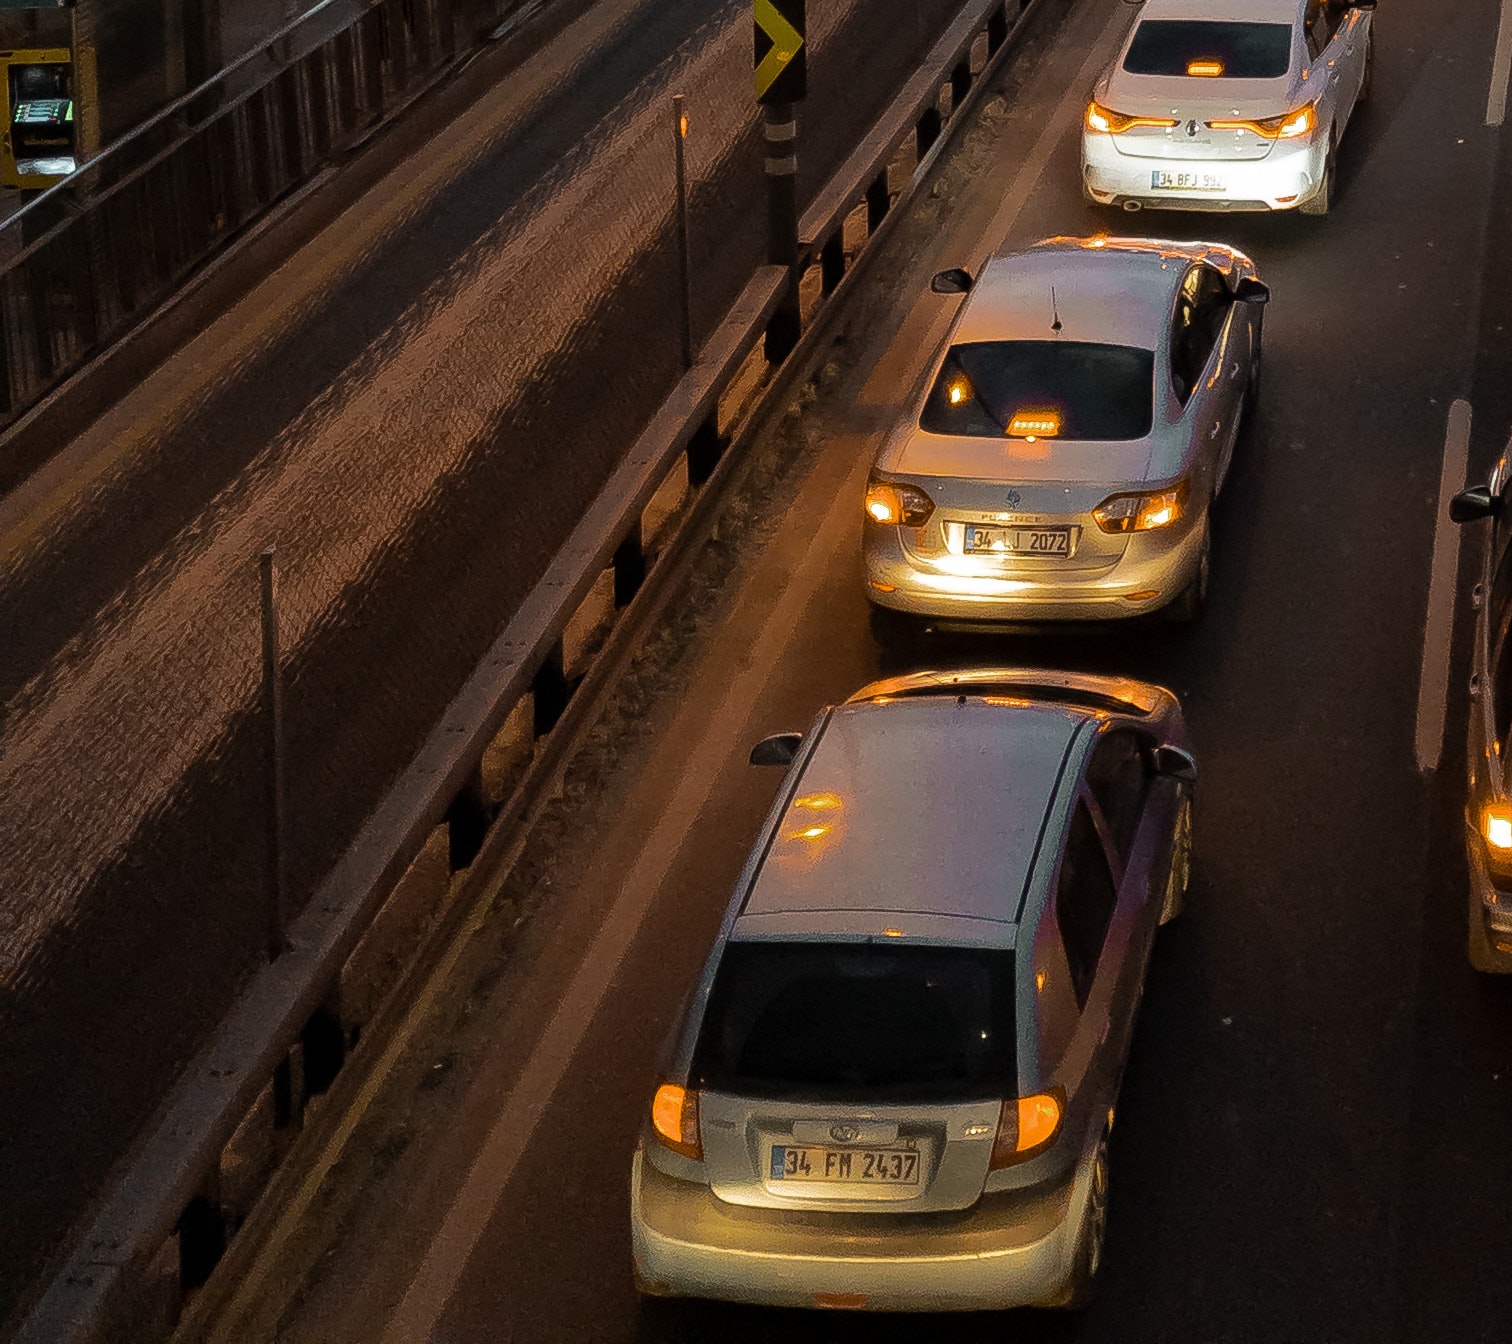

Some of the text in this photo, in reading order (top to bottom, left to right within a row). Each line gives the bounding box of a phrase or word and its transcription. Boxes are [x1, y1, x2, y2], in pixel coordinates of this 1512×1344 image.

[1160, 172, 1173, 185] 34
[974, 530, 991, 548] 34
[1030, 532, 1067, 552] 2072
[785, 1149, 919, 1182] 34 FM 2437
